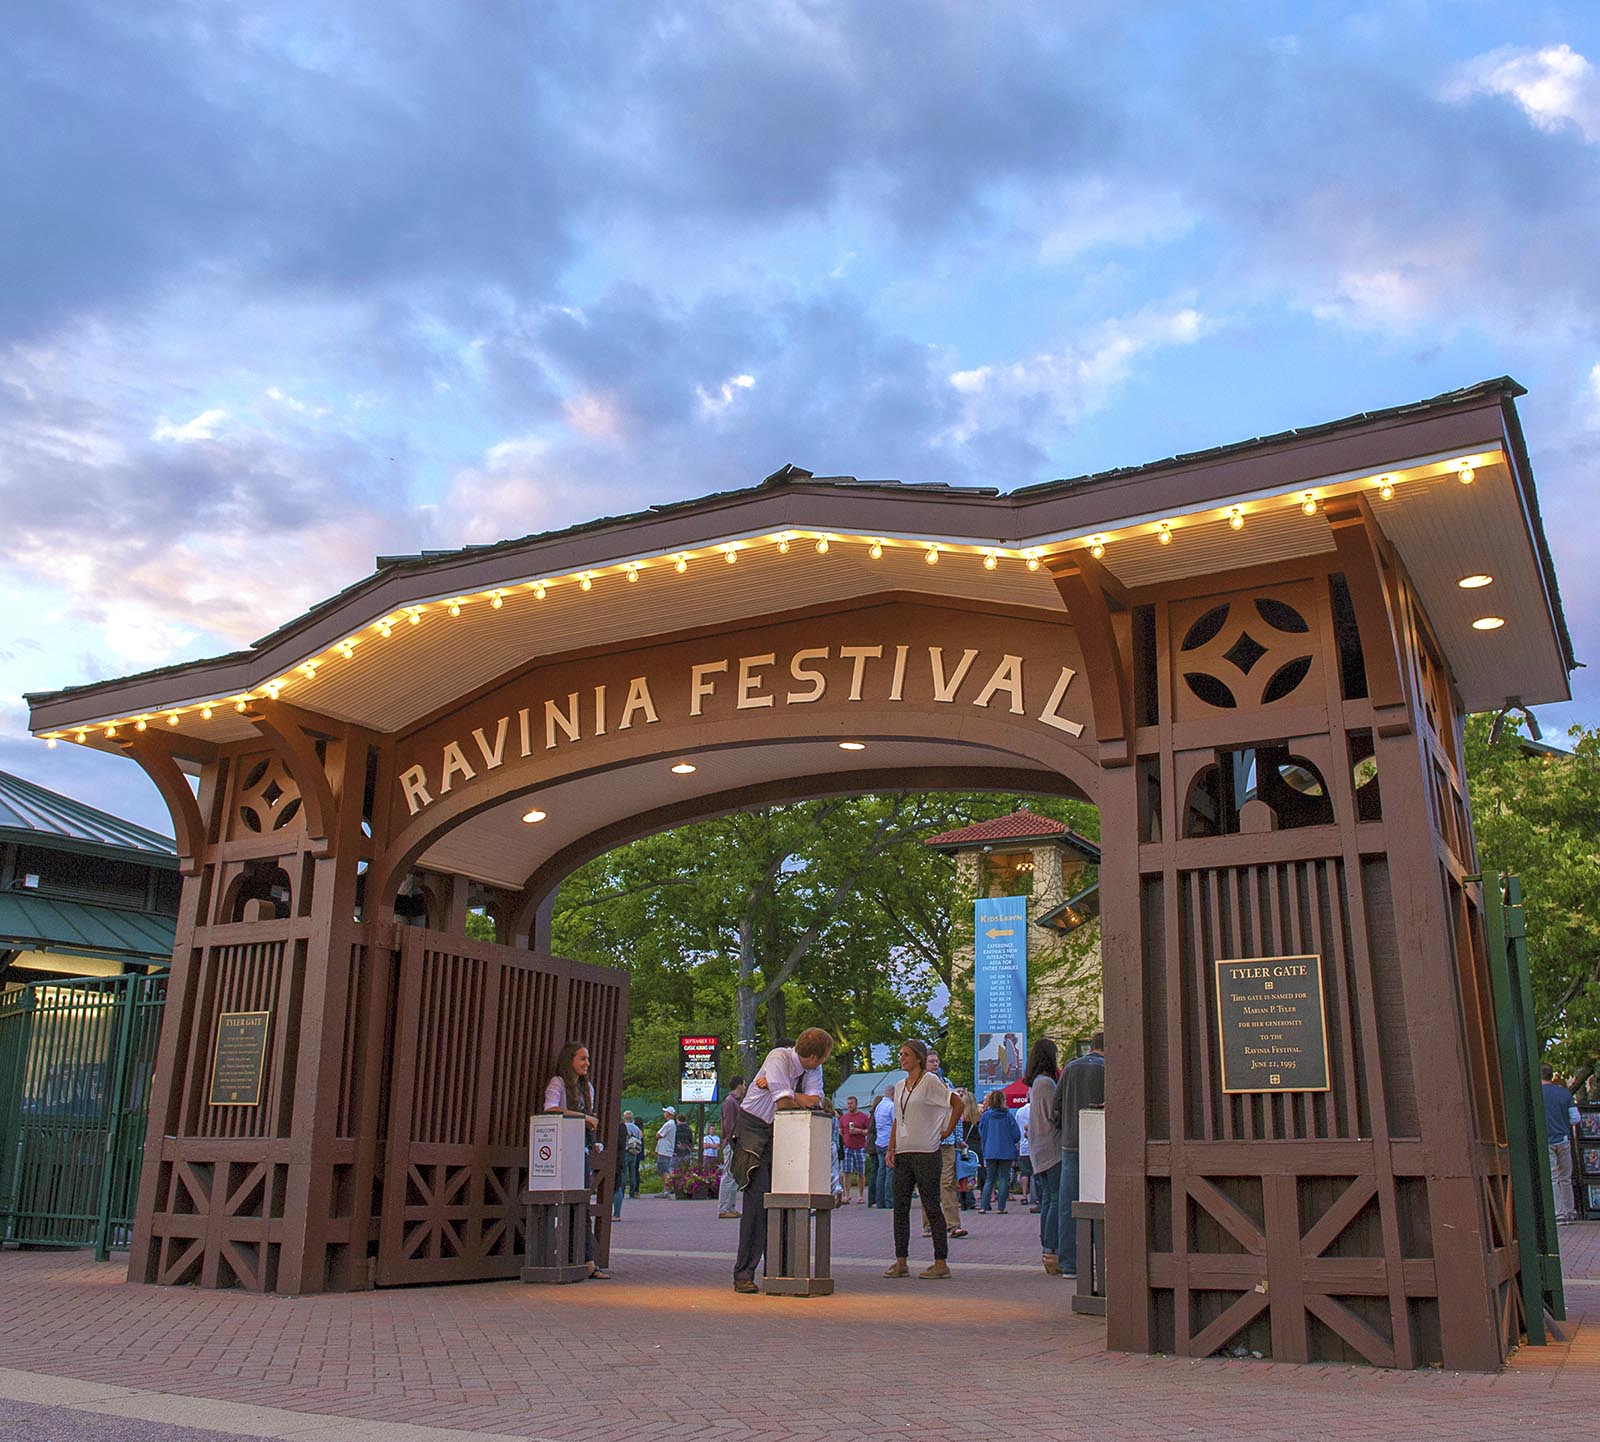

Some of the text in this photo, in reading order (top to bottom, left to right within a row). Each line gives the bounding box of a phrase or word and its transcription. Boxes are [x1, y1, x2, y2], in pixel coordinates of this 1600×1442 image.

[399, 645, 1084, 815] RAVINIA FESTIVAL
[1230, 965, 1308, 980] TYLER GATE
[1231, 994, 1246, 1002] THIS
[1277, 1005, 1296, 1013] TYLER
[1251, 1060, 1267, 1069] JUNE
[1280, 1060, 1296, 1069] 1995
